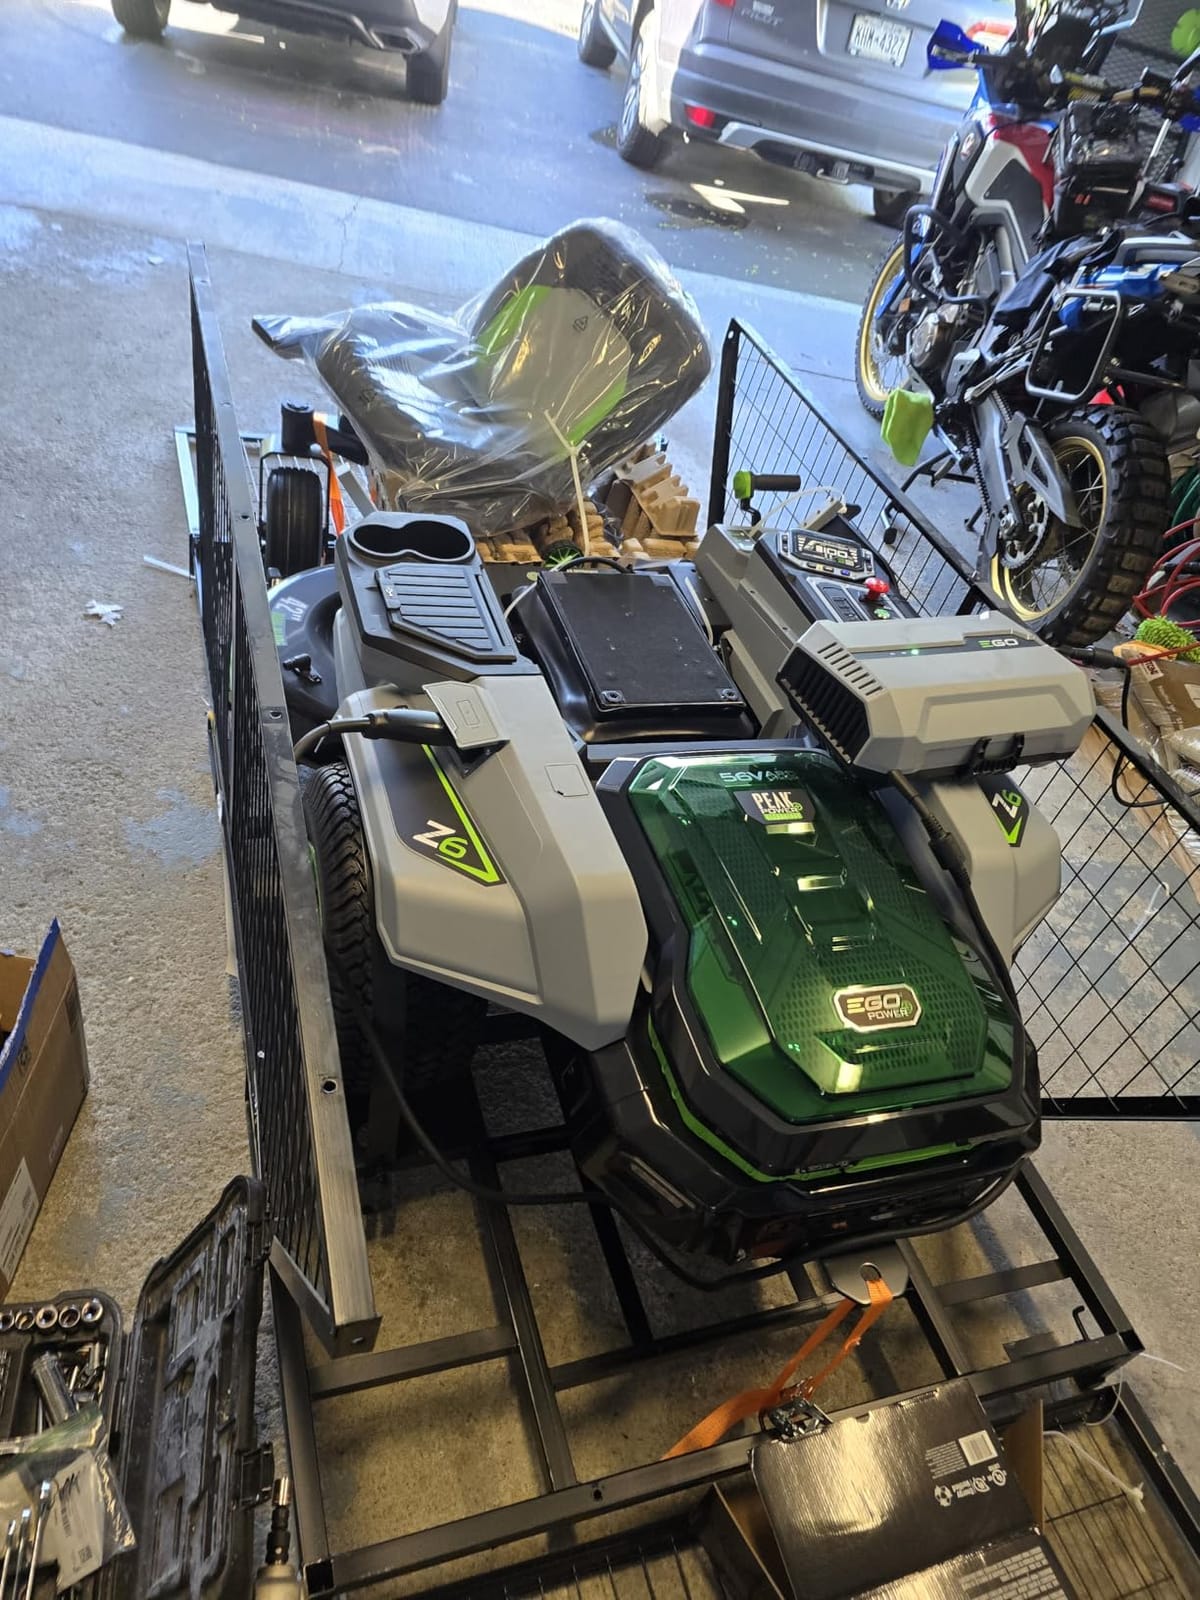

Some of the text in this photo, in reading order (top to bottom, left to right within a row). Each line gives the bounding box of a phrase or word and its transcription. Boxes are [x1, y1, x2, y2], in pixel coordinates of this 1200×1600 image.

[977, 638, 1019, 648] EGO
[718, 771, 763, 782] 56V
[751, 791, 793, 810] PEAK
[992, 789, 1022, 818] Z6
[412, 819, 469, 859] Z6
[846, 993, 901, 1014] EGO
[867, 1007, 909, 1020] POWER
